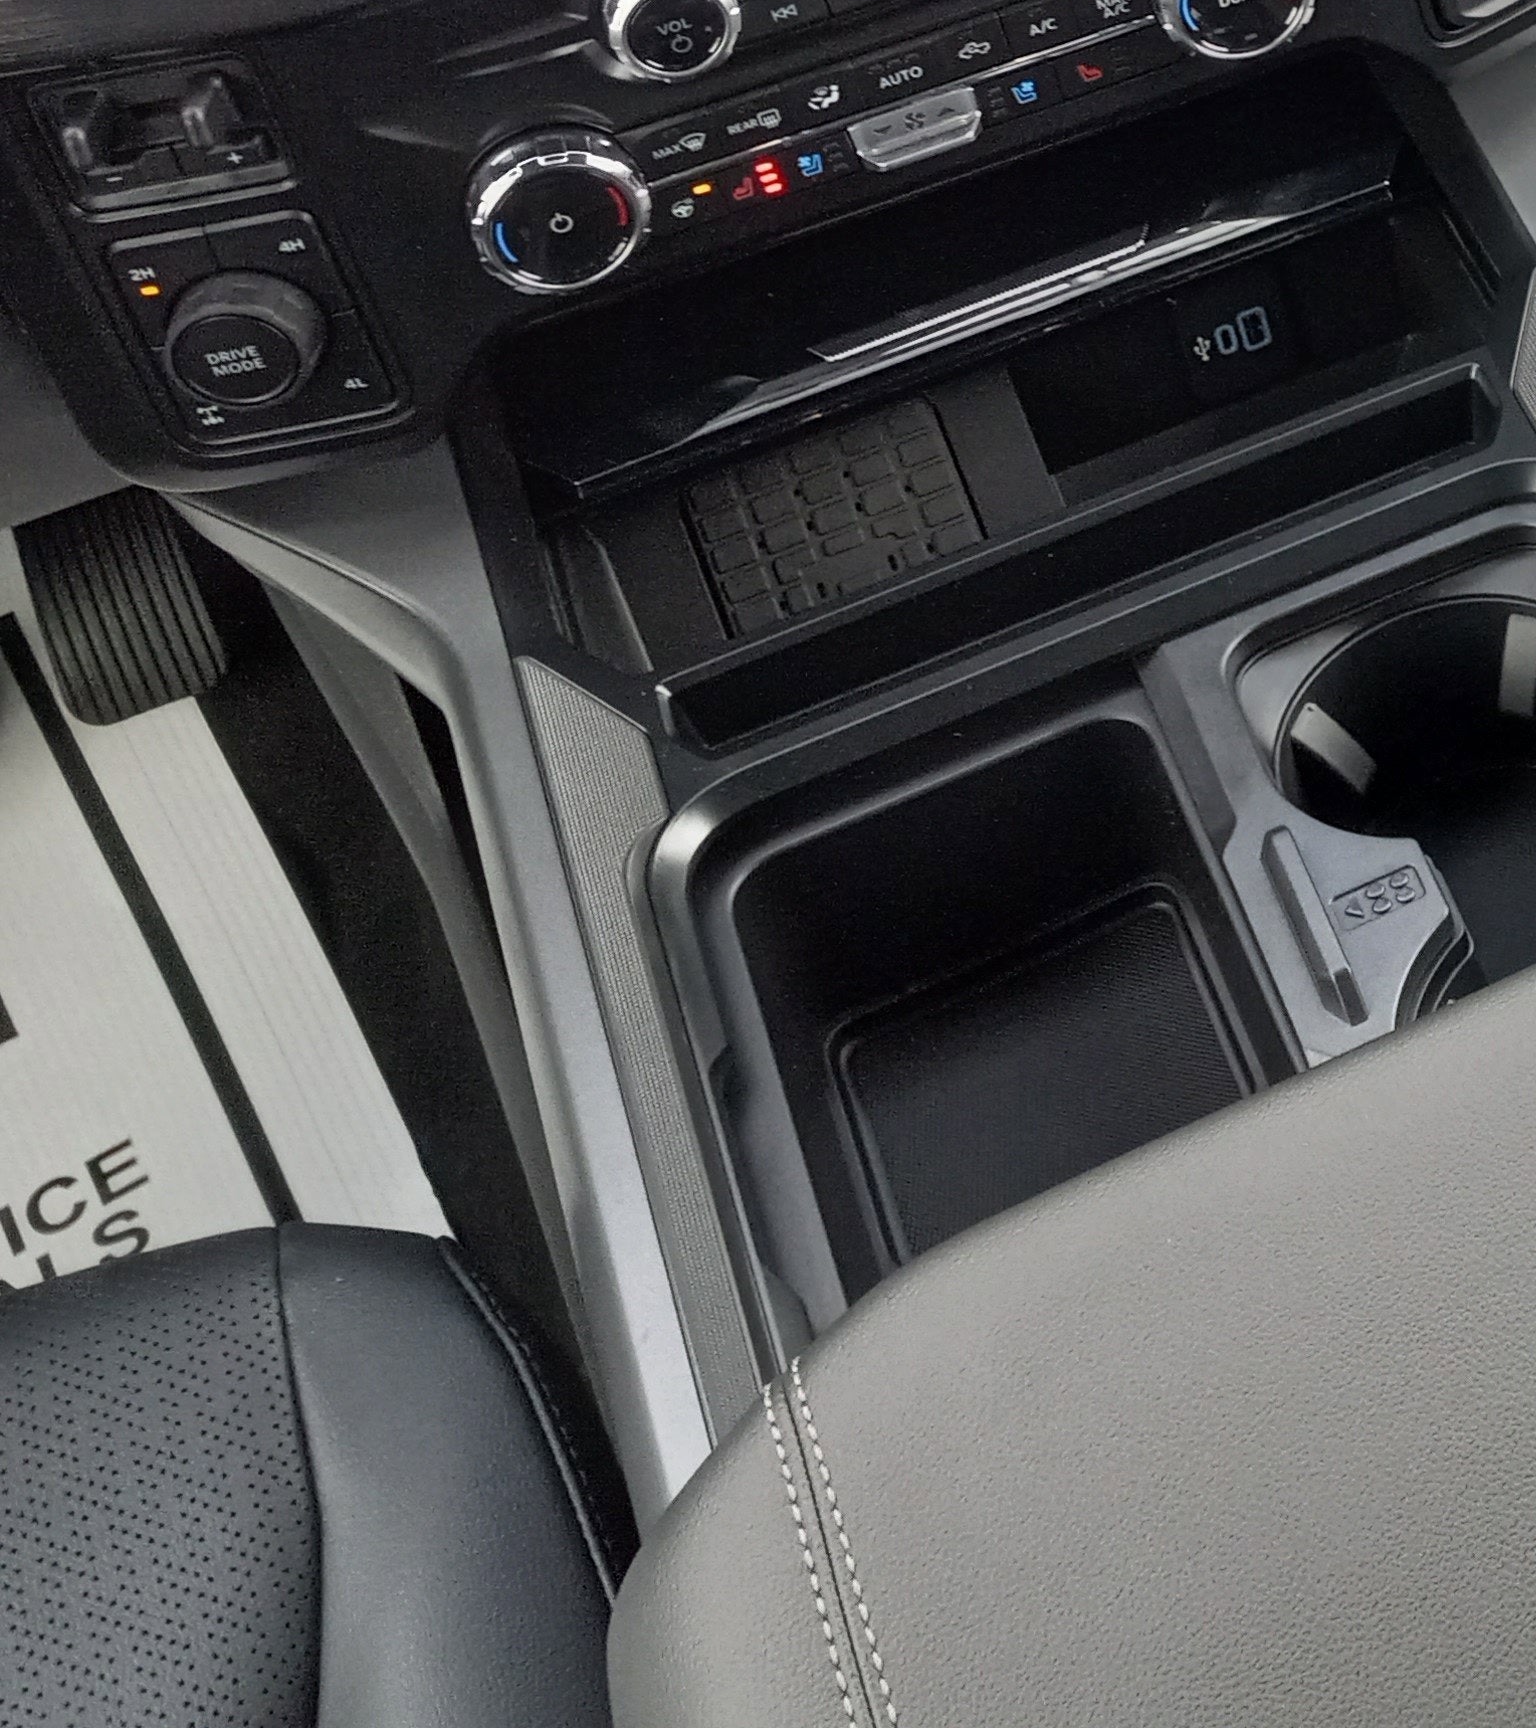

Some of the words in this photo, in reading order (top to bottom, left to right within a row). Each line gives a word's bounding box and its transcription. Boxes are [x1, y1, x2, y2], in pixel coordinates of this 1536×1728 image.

[1102, 1, 1131, 19] A/C
[656, 17, 694, 38] VOL
[1029, 17, 1058, 38] A/C
[878, 66, 924, 89] AUTO
[726, 118, 759, 136] REAR
[651, 143, 682, 160] MAX
[278, 238, 306, 253] 4H
[128, 267, 156, 282] 2H
[205, 345, 261, 366] DRIVE
[211, 357, 267, 377] MODE
[344, 377, 369, 390] 4L
